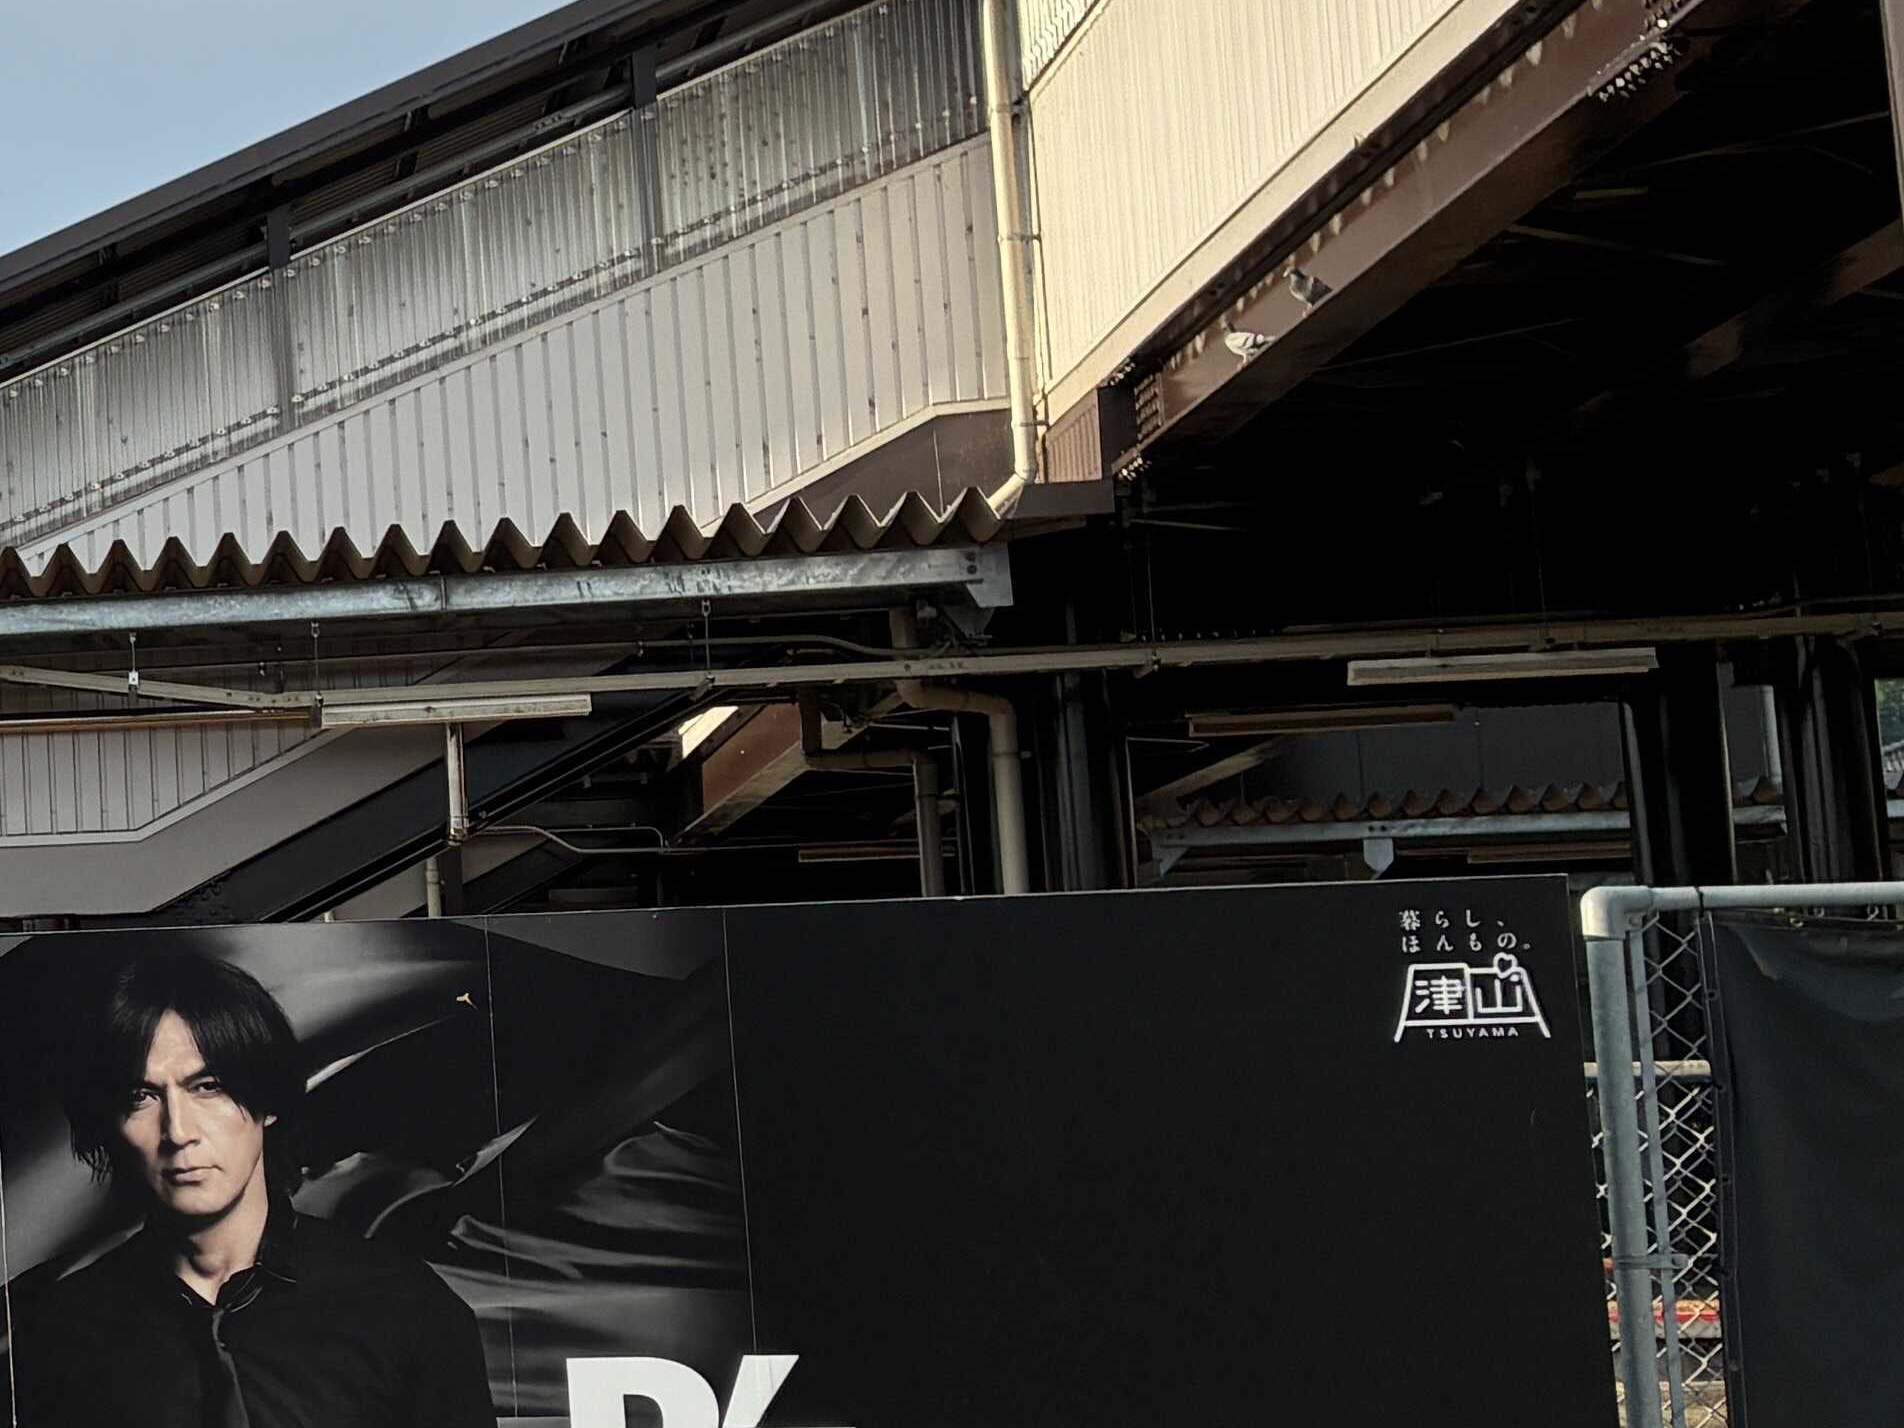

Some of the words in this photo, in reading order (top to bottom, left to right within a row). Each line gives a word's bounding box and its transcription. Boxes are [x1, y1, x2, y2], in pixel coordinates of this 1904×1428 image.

[1402, 932, 1531, 953] ほんもの。
[1414, 975, 1523, 1014] 津山
[1426, 1027, 1519, 1039] TSUYAMA
